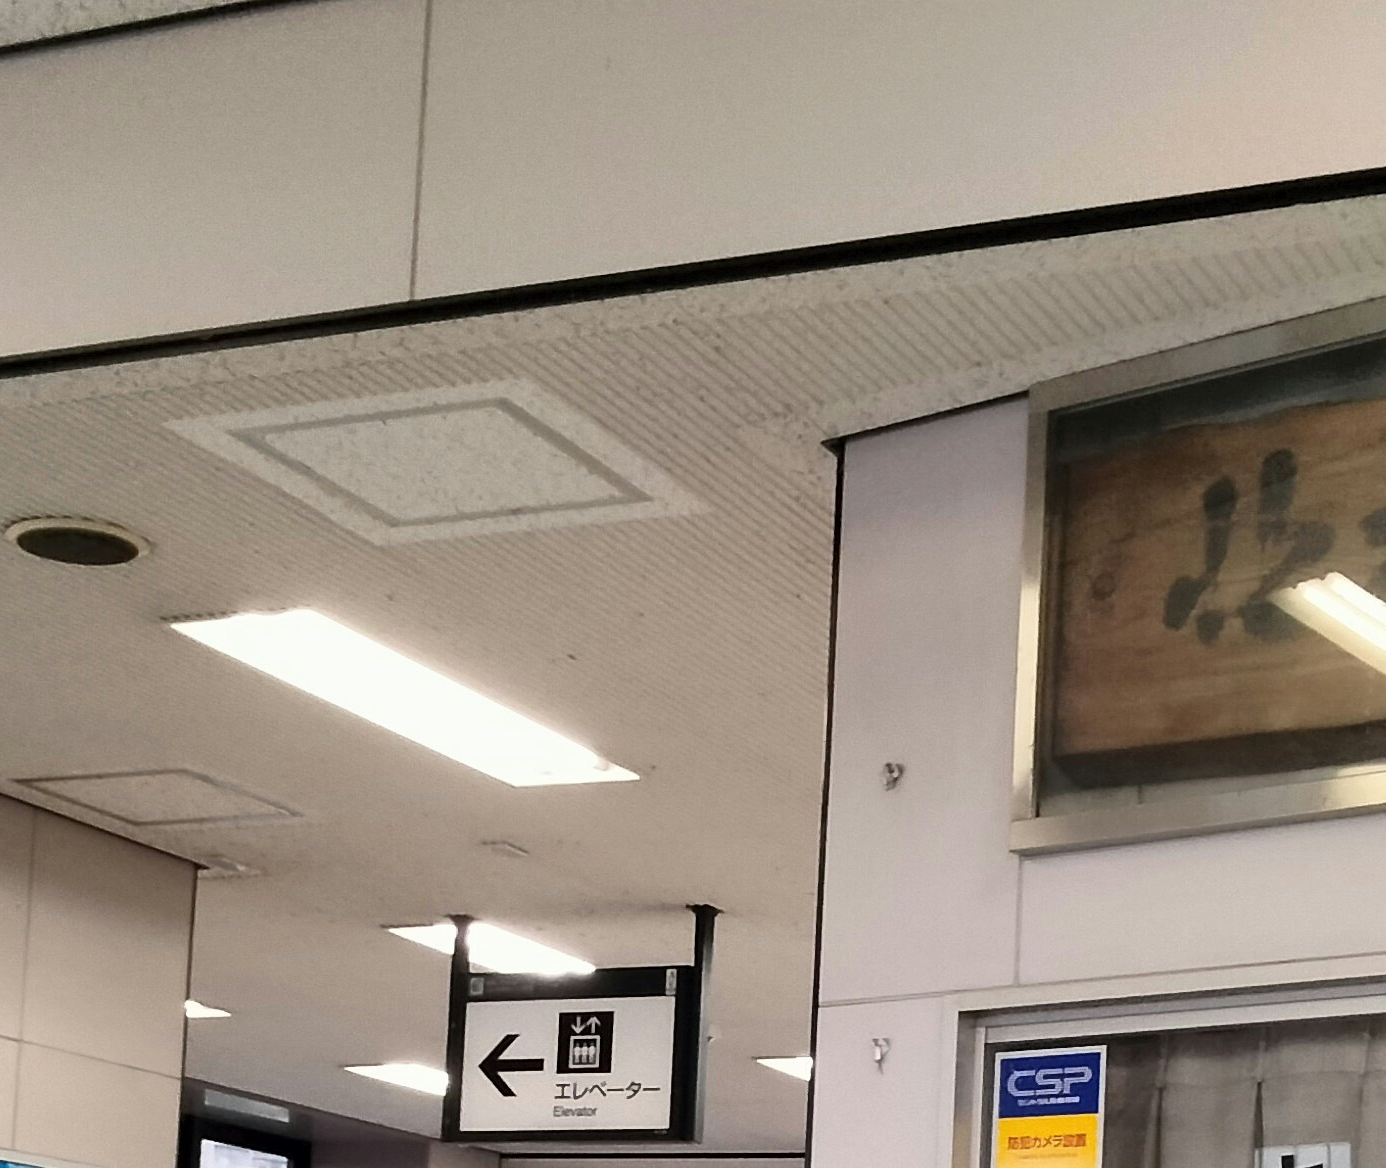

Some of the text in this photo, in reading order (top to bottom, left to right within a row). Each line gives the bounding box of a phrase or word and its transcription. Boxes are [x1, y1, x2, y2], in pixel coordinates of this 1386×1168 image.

[553, 1081, 661, 1100] エレベーター
[1007, 1066, 1093, 1097] CSP
[553, 1106, 597, 1118] Elevator
[1008, 1133, 1087, 1150] 防犯カメラ設置
